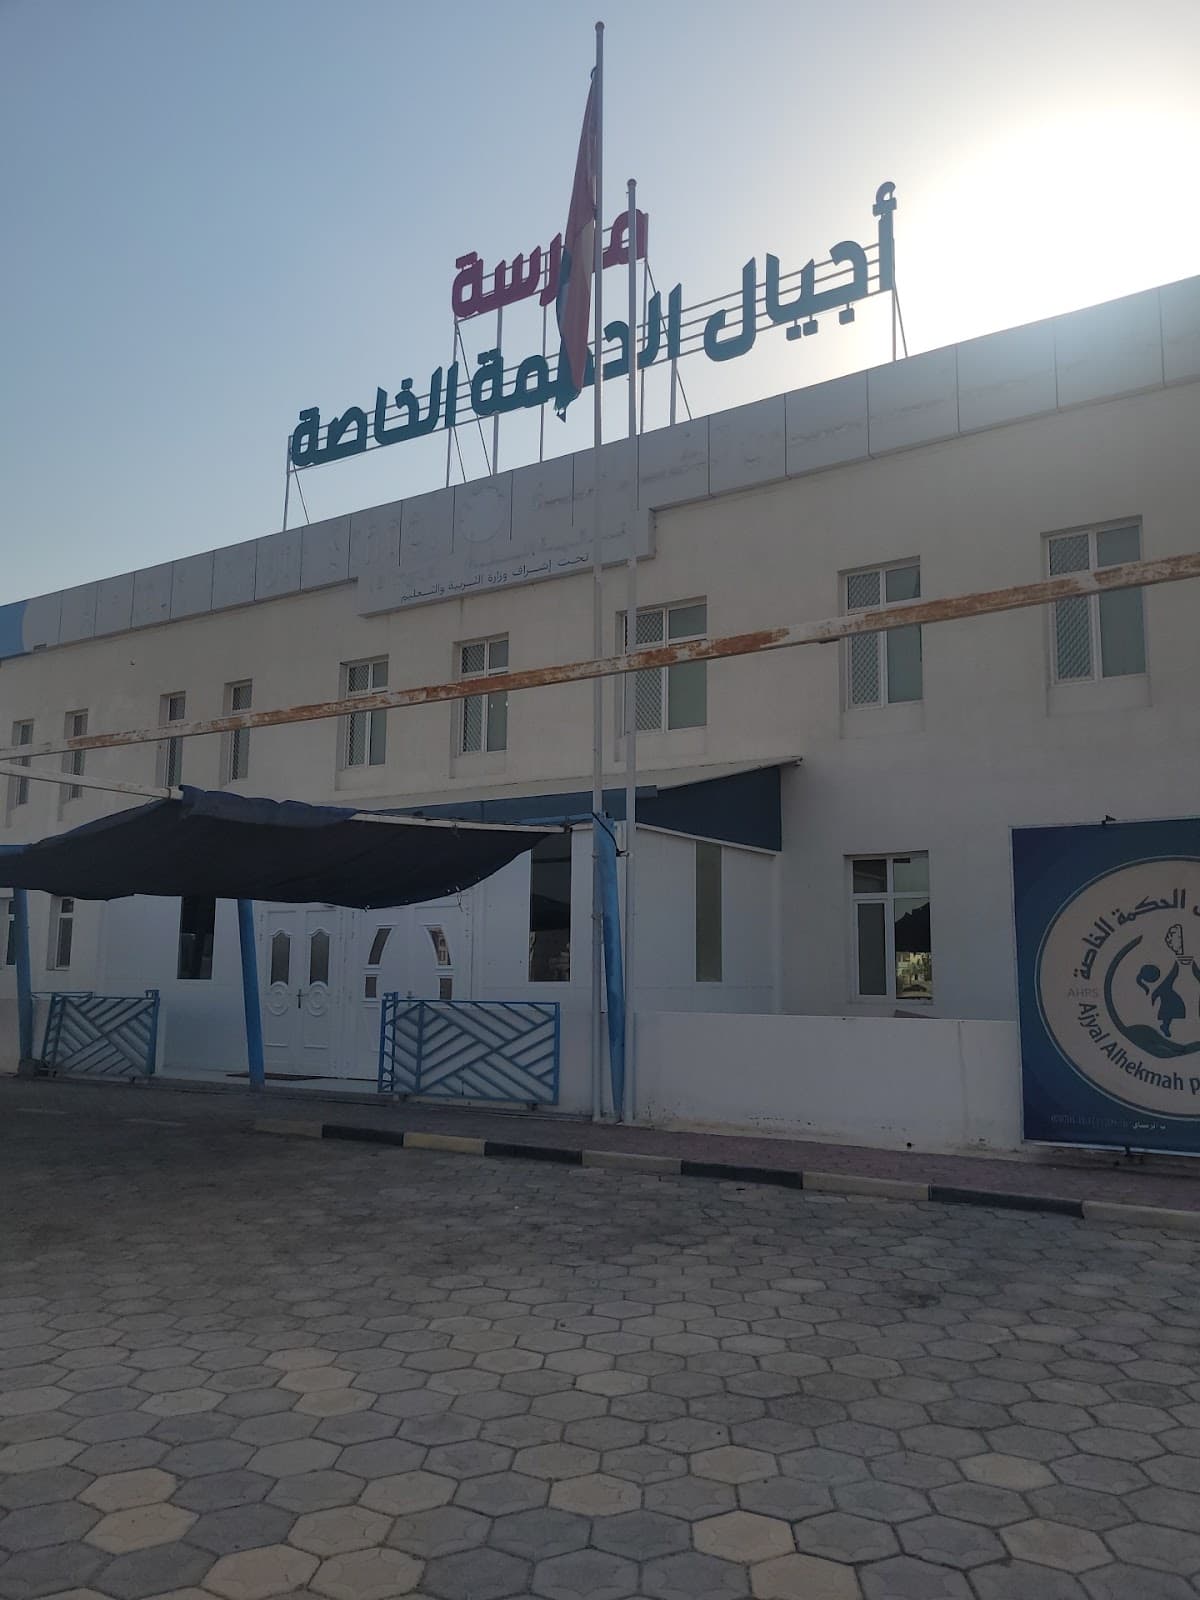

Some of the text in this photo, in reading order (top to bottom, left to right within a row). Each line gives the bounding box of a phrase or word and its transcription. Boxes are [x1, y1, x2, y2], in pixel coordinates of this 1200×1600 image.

[452, 208, 649, 319] مرسة
[291, 181, 897, 468] أجيال الحمة الخاصة
[487, 570, 508, 584] وزارة
[1073, 888, 1186, 980] الحكمة الخاصة
[1077, 1002, 1110, 1043] Ajyal
[1100, 1042, 1184, 1091] Alhekmah
